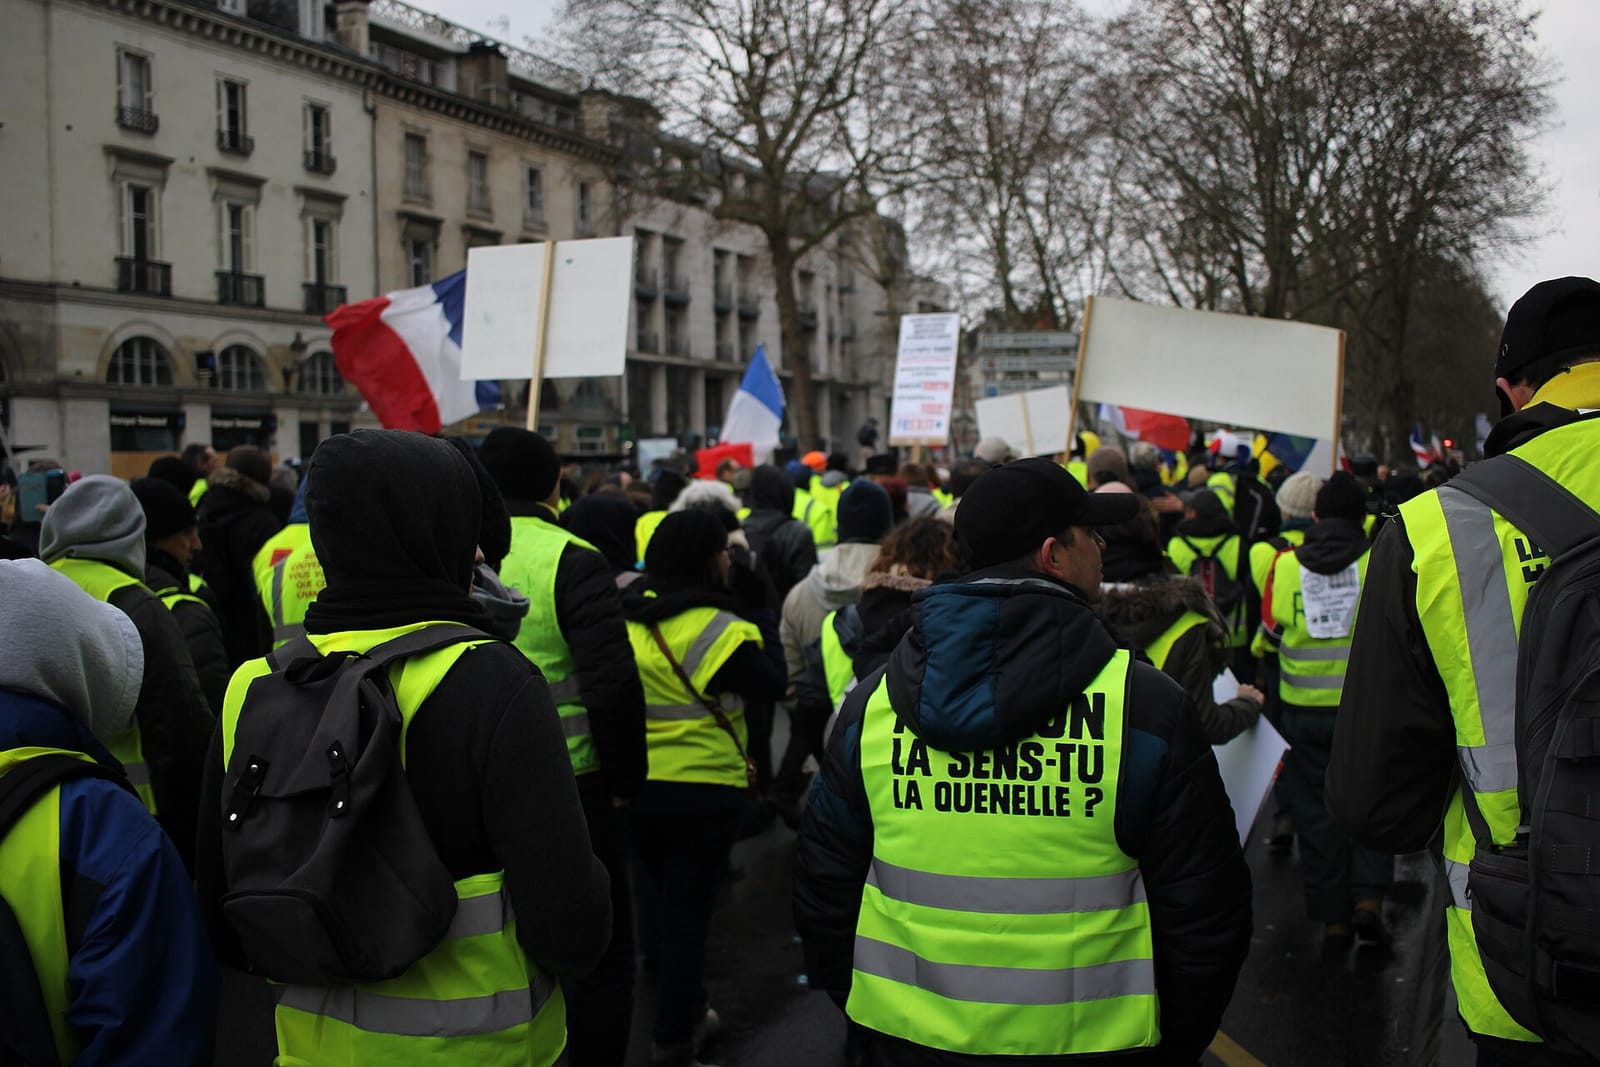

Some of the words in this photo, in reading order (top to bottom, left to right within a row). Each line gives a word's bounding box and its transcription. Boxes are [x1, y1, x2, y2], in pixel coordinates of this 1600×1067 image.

[892, 738, 932, 777] LA
[947, 742, 1104, 784] SENS-TU
[893, 779, 923, 810] LA
[934, 781, 1071, 818] QUENELLE
[1084, 787, 1104, 817] ?
